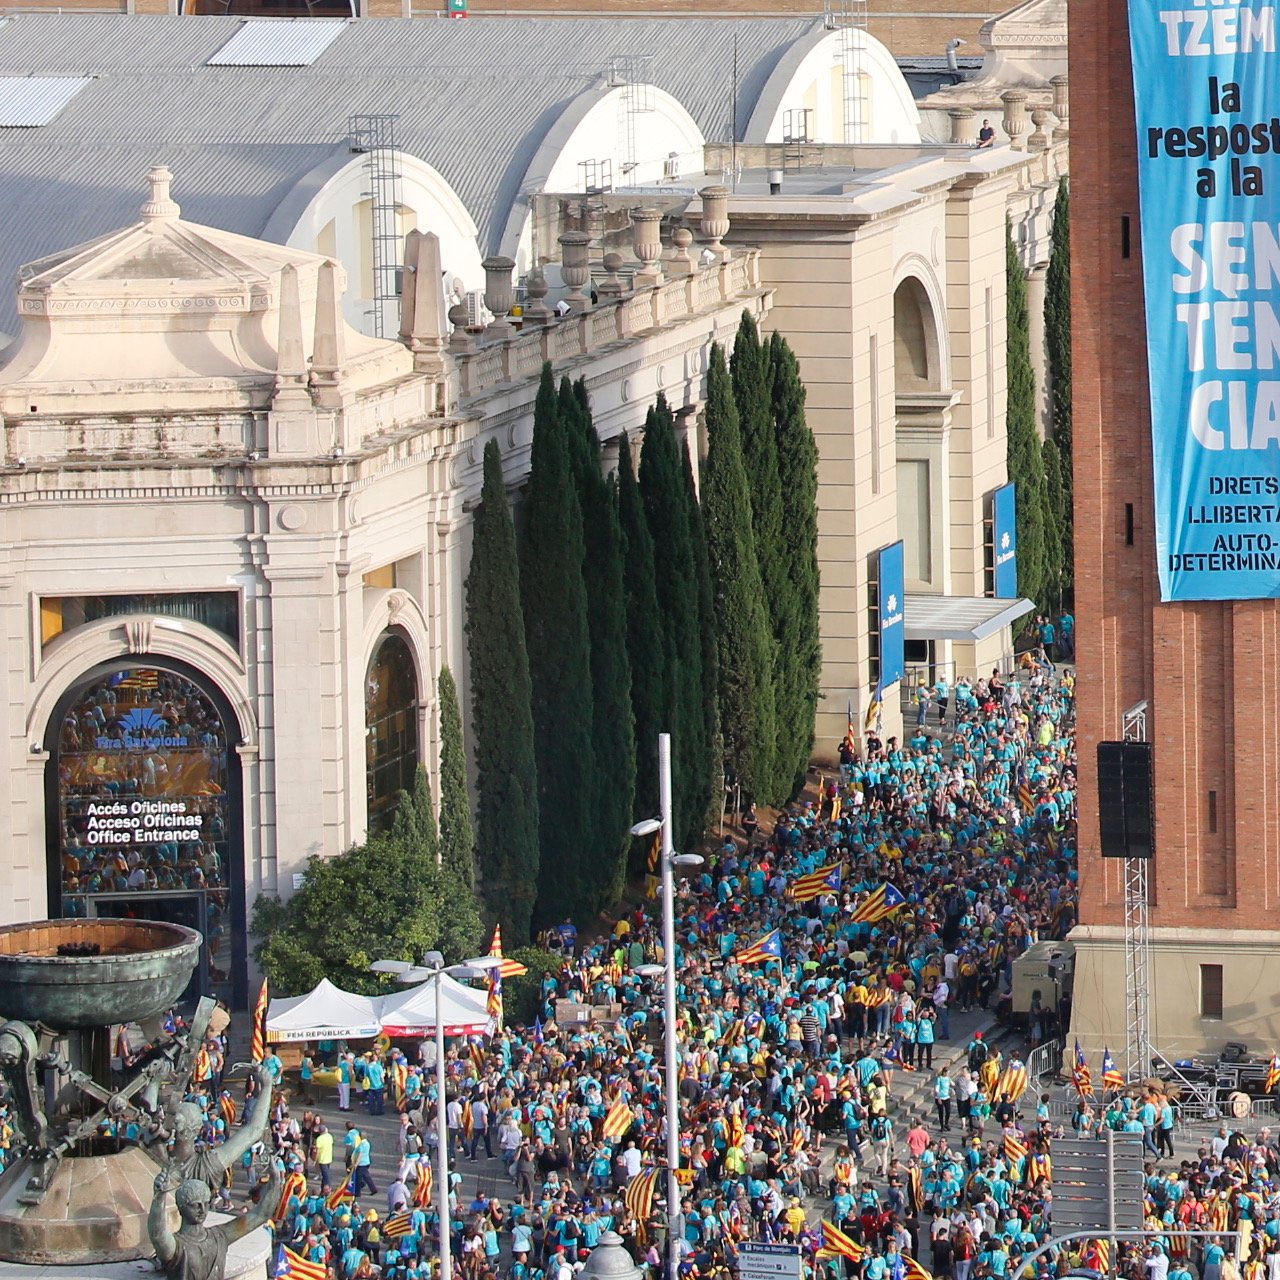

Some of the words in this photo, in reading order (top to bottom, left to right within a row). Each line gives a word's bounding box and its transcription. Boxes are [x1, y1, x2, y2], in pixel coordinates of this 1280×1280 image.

[1160, 7, 1276, 56] TZEM
[1209, 77, 1240, 115] la
[1197, 168, 1216, 197] a
[1231, 158, 1264, 196] la
[1209, 476, 1279, 495] DRETS
[1212, 533, 1279, 552] AUTO-
[96, 736, 121, 749] Fira
[124, 734, 188, 748] Barcelona
[87, 801, 128, 816] Accés
[131, 801, 186, 814] Oficines
[87, 816, 140, 830] Acceso
[144, 814, 203, 828] Oficinas
[87, 830, 131, 844] Office
[135, 828, 199, 842] Entrance
[286, 1031, 304, 1039] FEM
[305, 1028, 350, 1038] REPÚBLICA
